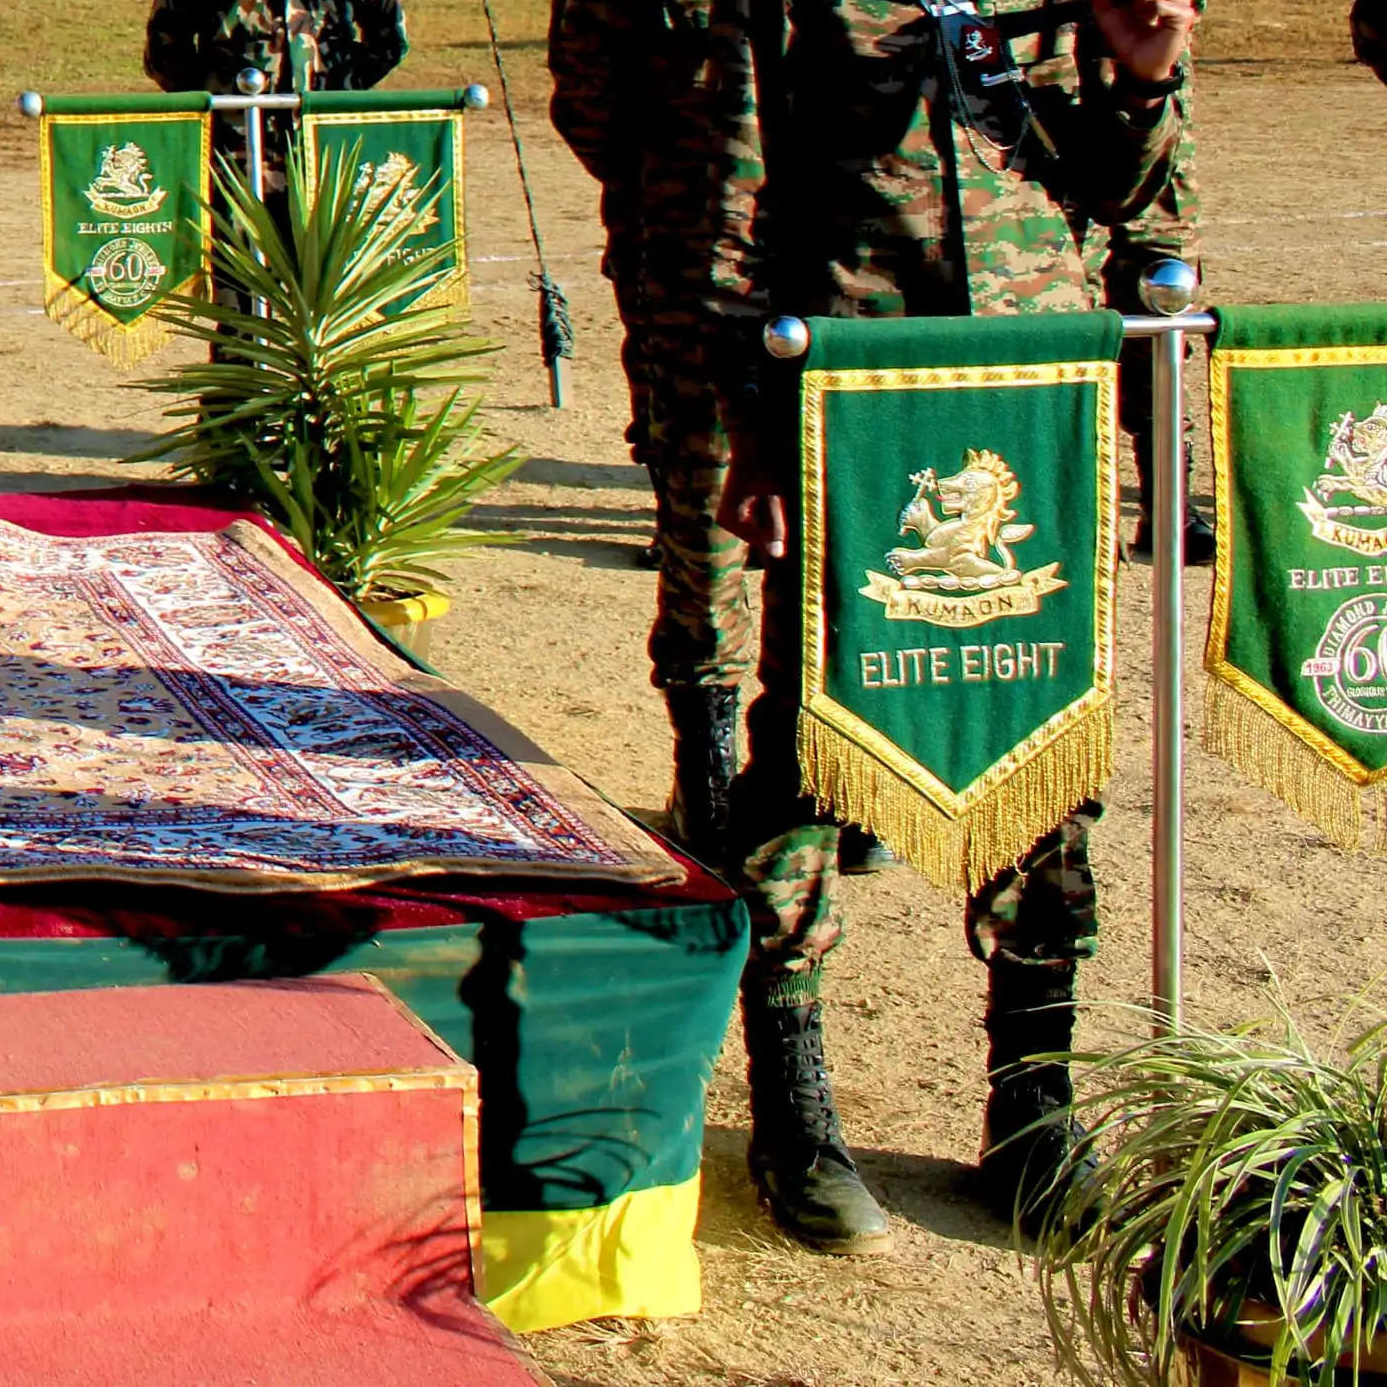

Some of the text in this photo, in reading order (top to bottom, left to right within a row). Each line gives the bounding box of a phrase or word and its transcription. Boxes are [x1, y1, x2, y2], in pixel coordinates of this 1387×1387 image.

[77, 222, 120, 235] ELITE
[109, 251, 144, 282] 60
[1287, 566, 1359, 590] ELITE
[907, 595, 1014, 620] KUMAON
[1323, 600, 1376, 657] DIAMOND
[859, 641, 1066, 689] ELITE EIGHT
[1306, 661, 1333, 674] 1963
